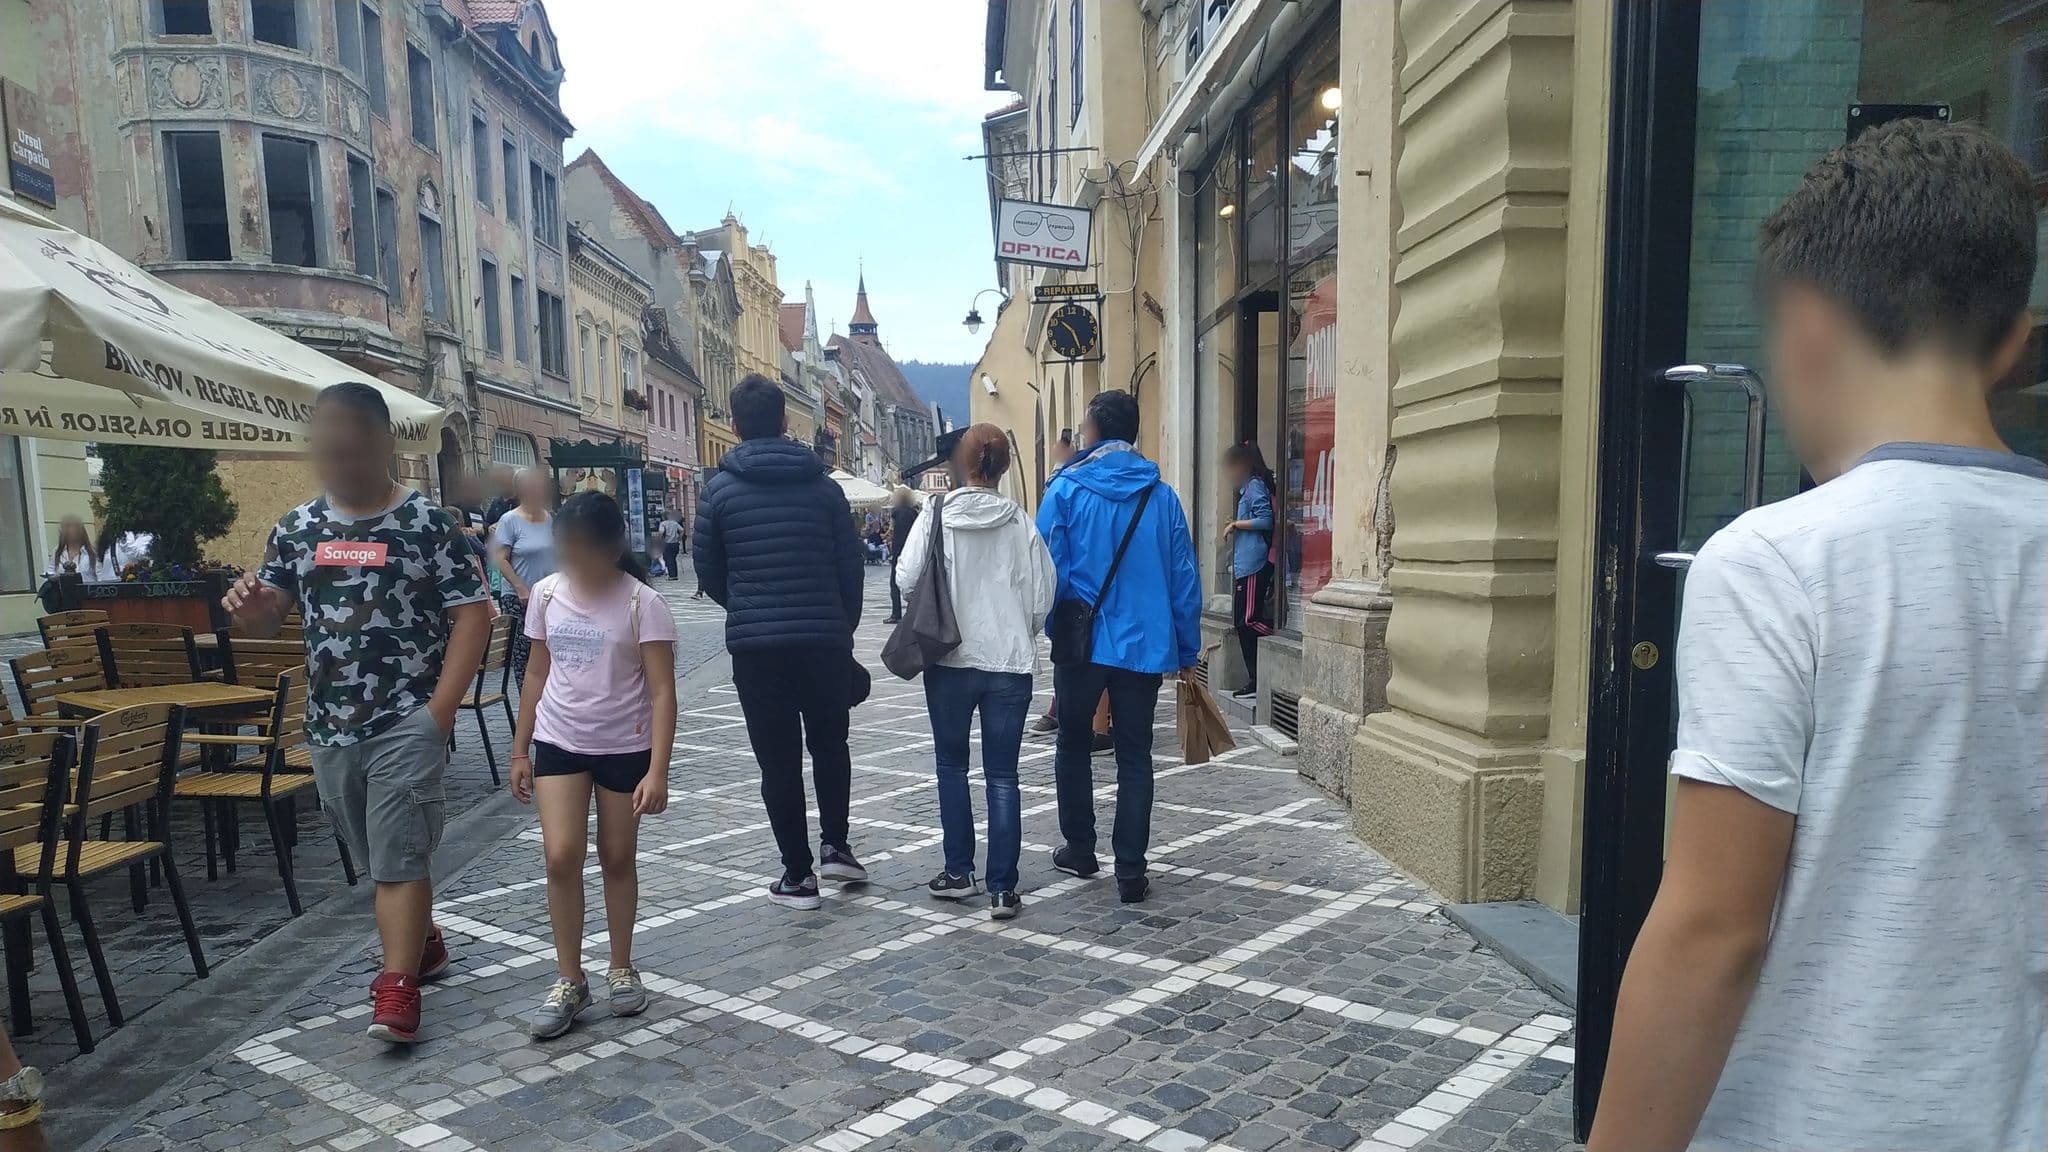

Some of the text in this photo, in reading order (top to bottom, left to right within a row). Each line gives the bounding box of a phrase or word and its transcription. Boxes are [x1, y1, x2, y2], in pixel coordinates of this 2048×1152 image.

[17, 128, 43, 152] Ursul
[12, 141, 50, 169] Carpatin
[1001, 241, 1081, 262] OPTICA
[1057, 309, 1065, 318] 11
[1068, 306, 1077, 315] 12
[1092, 326, 1098, 335] 3
[1081, 346, 1087, 354] 5
[1306, 321, 1337, 402] PROM
[193, 375, 262, 415] REGELE
[323, 546, 377, 564] Savage
